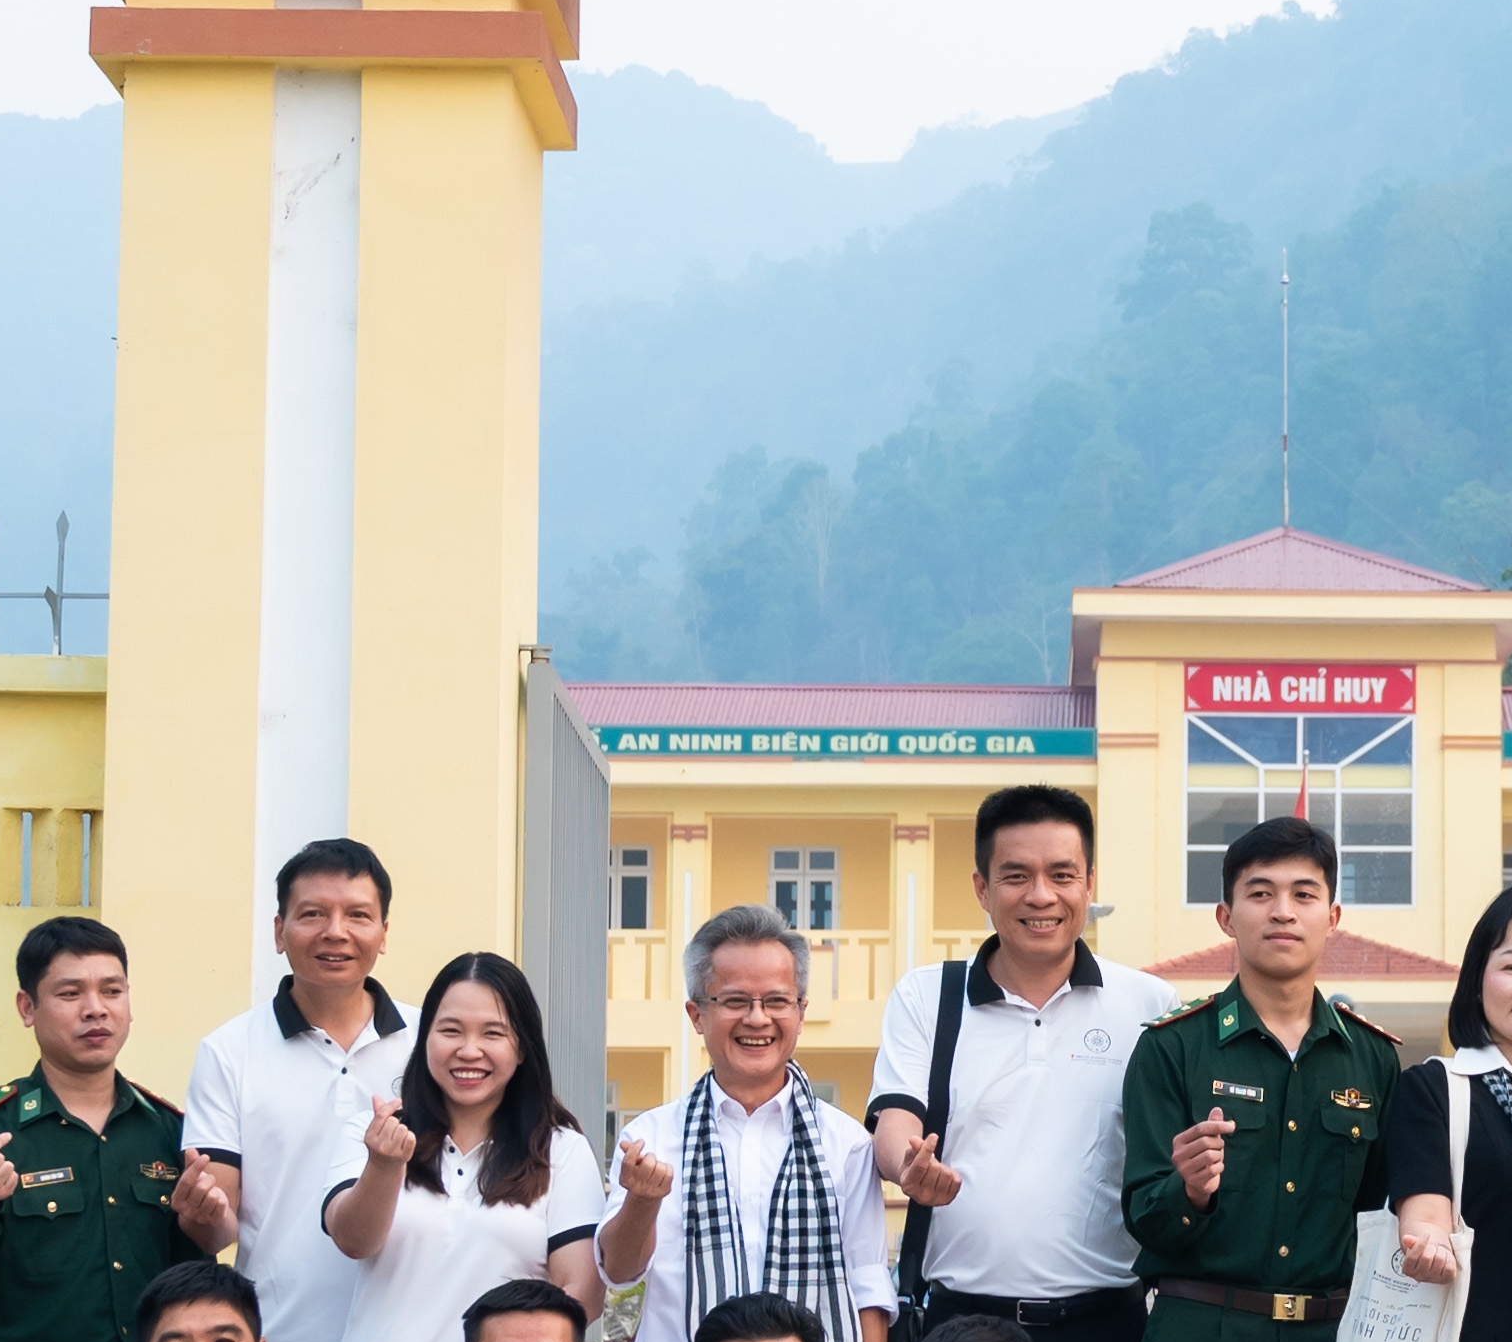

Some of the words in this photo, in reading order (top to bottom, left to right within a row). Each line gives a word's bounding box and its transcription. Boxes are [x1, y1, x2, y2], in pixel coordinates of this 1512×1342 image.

[1212, 670, 1271, 702] NHÀ
[1280, 667, 1327, 703] CHỈ
[1334, 677, 1387, 703] HUY
[618, 734, 659, 751] AN
[669, 734, 743, 751] NINH
[751, 731, 821, 752] BIÊN
[830, 730, 889, 753] GIỚI
[898, 729, 976, 754] QUỐC
[986, 735, 1035, 753] GIA
